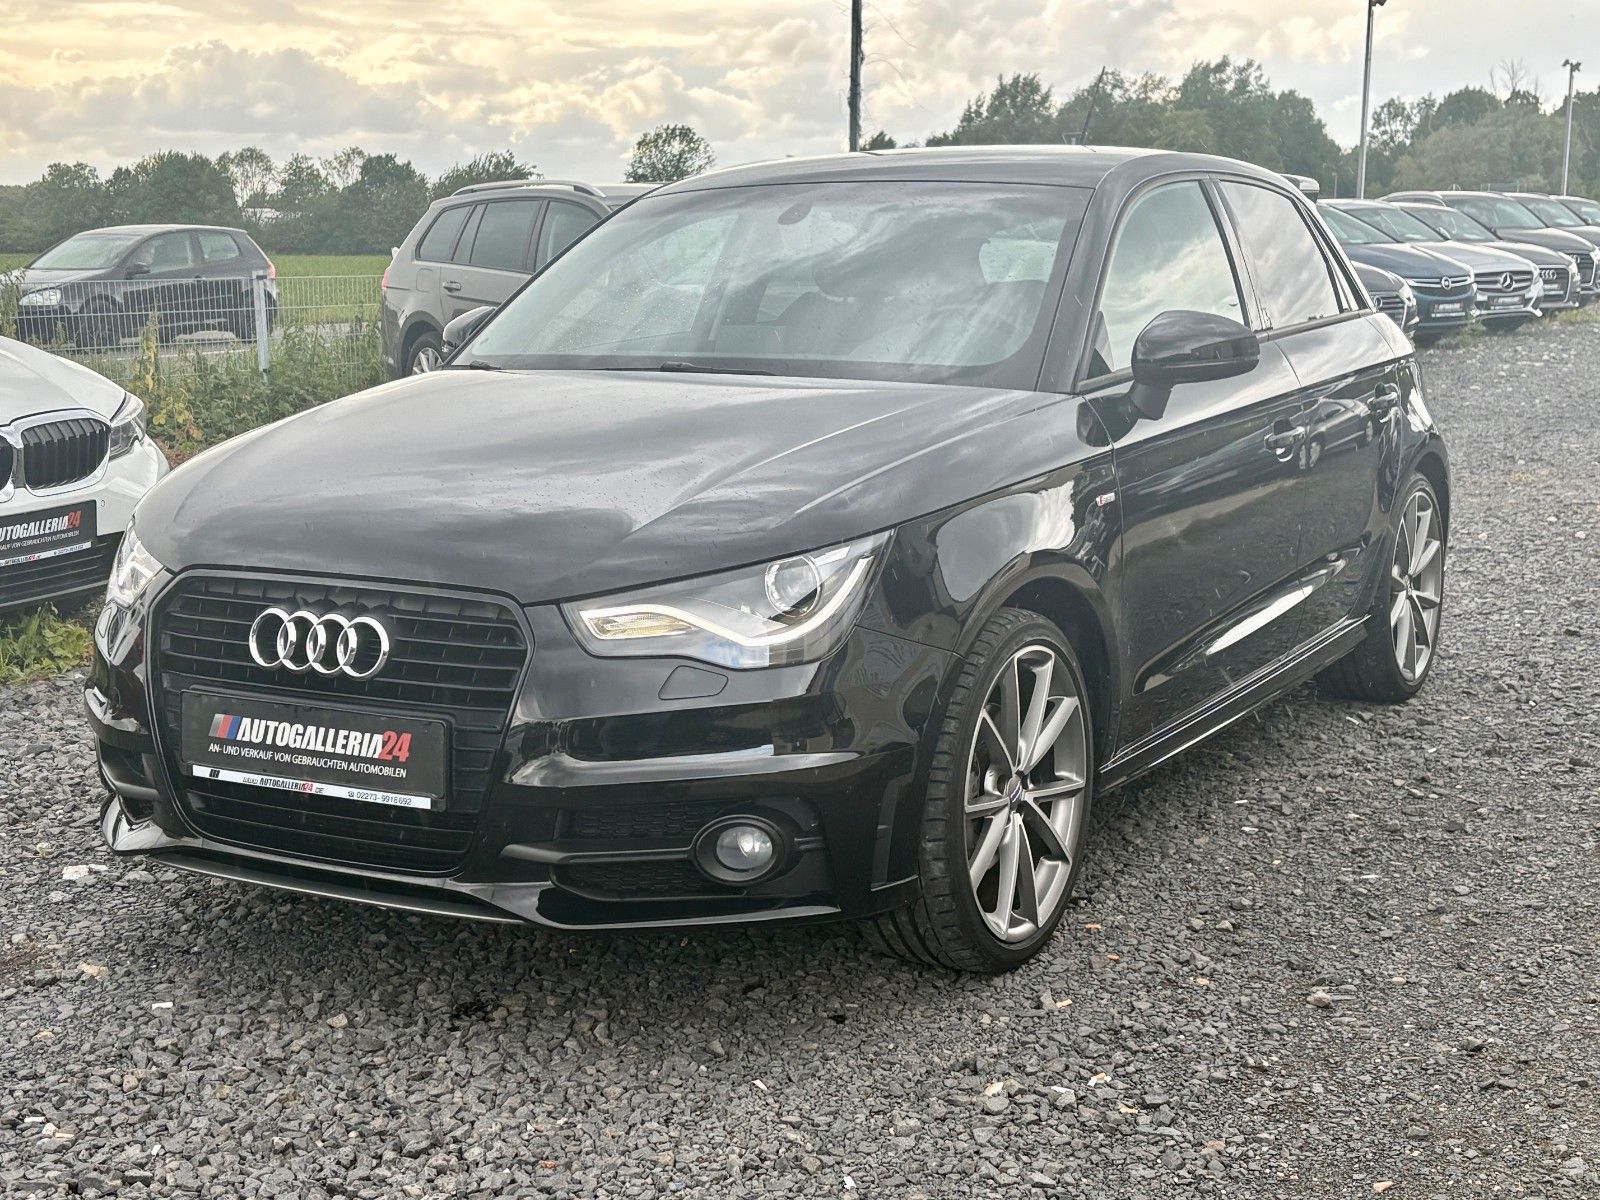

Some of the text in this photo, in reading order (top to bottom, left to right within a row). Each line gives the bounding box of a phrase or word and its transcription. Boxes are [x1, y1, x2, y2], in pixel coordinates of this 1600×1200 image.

[236, 717, 412, 762] AUTOGALLERIA24
[208, 743, 407, 779] AN- UND VERKAUF VON GEBRAUCHTEN AUTOMOBILEN
